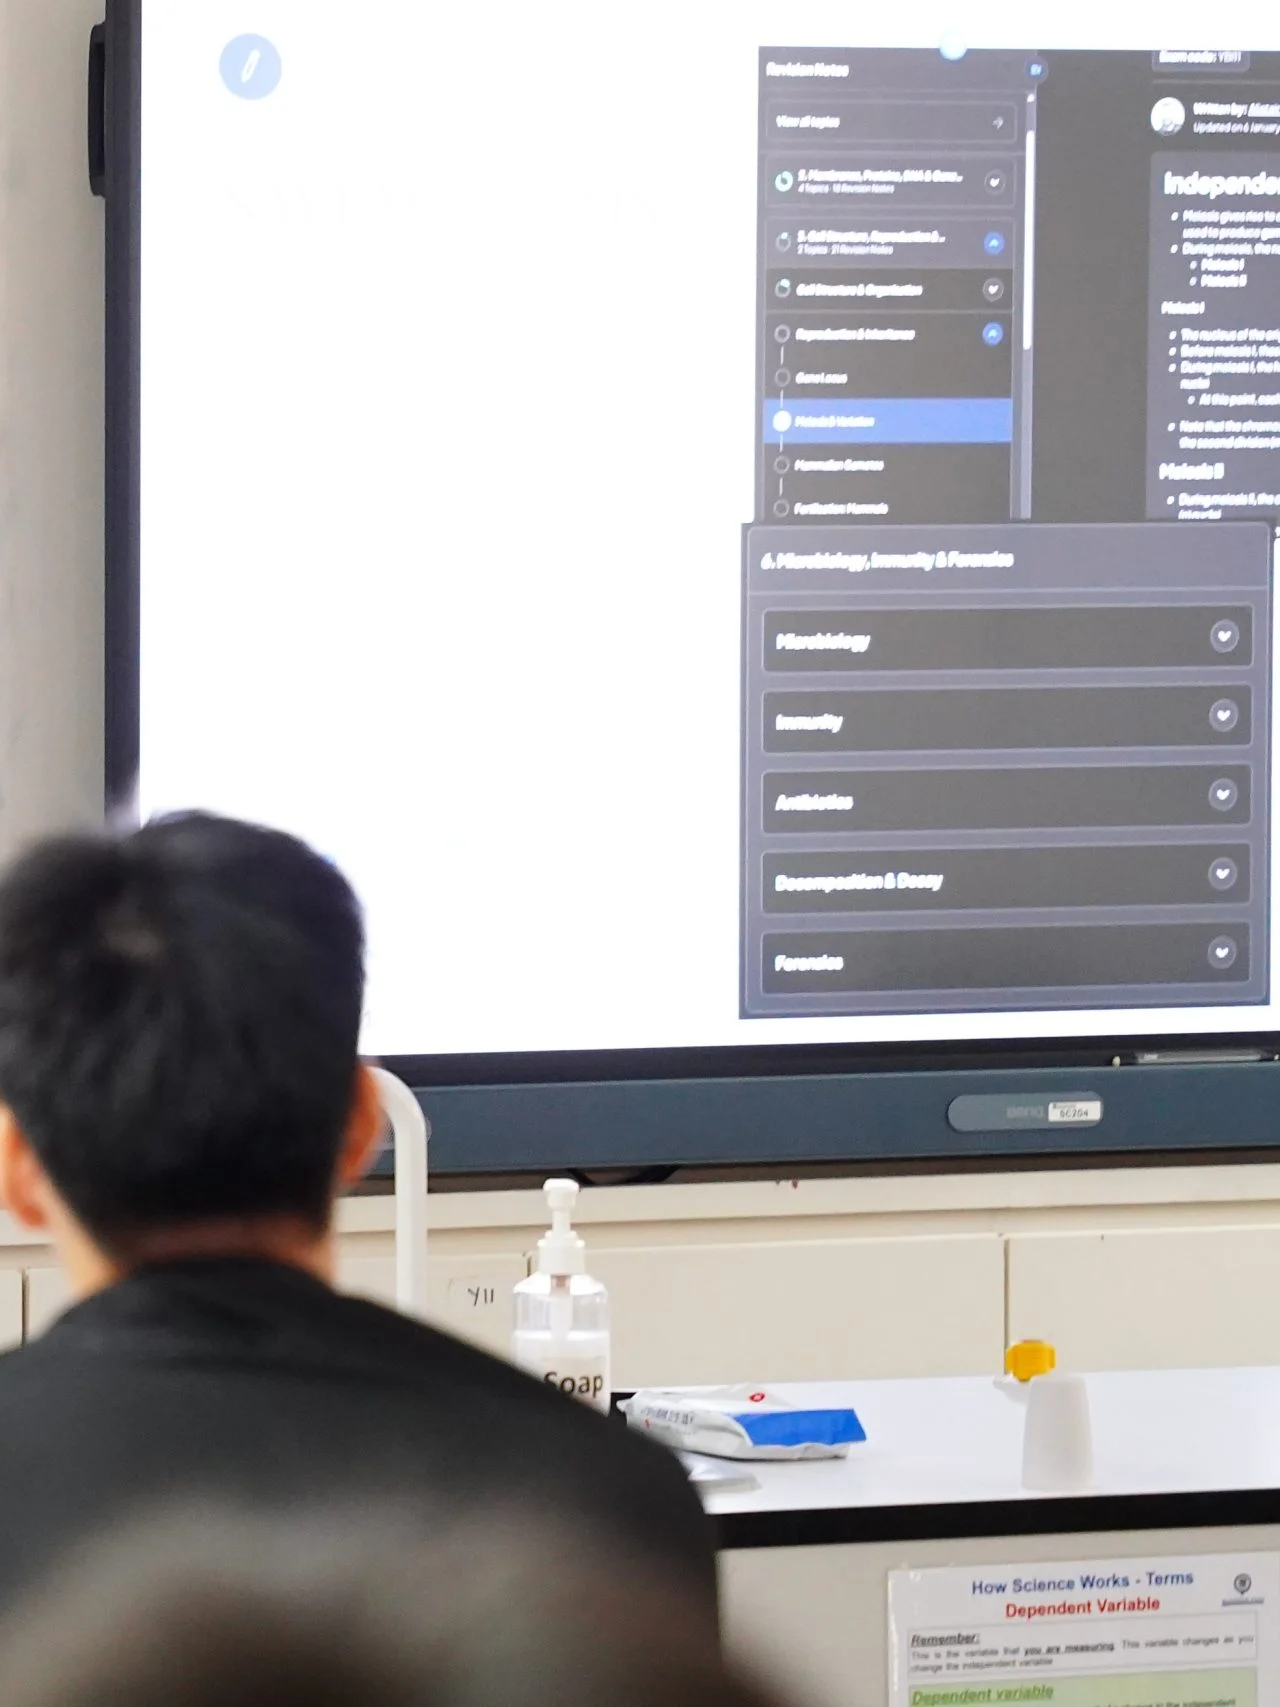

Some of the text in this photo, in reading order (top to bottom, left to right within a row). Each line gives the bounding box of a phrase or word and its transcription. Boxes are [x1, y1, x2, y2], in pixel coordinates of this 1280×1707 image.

[776, 632, 871, 652] Microbiology
[775, 713, 844, 733] Immunity
[775, 793, 854, 811] Antibiotics
[775, 873, 884, 893] Decomposition
[897, 872, 944, 892] Decay
[775, 954, 844, 972] Forensics
[543, 1371, 603, 1399] Soap
[971, 1579, 1007, 1595] How
[1012, 1577, 1075, 1594] Science
[1079, 1573, 1131, 1590] Works
[1146, 1571, 1194, 1587] Terms
[1005, 1597, 1161, 1619] Dependent Variable
